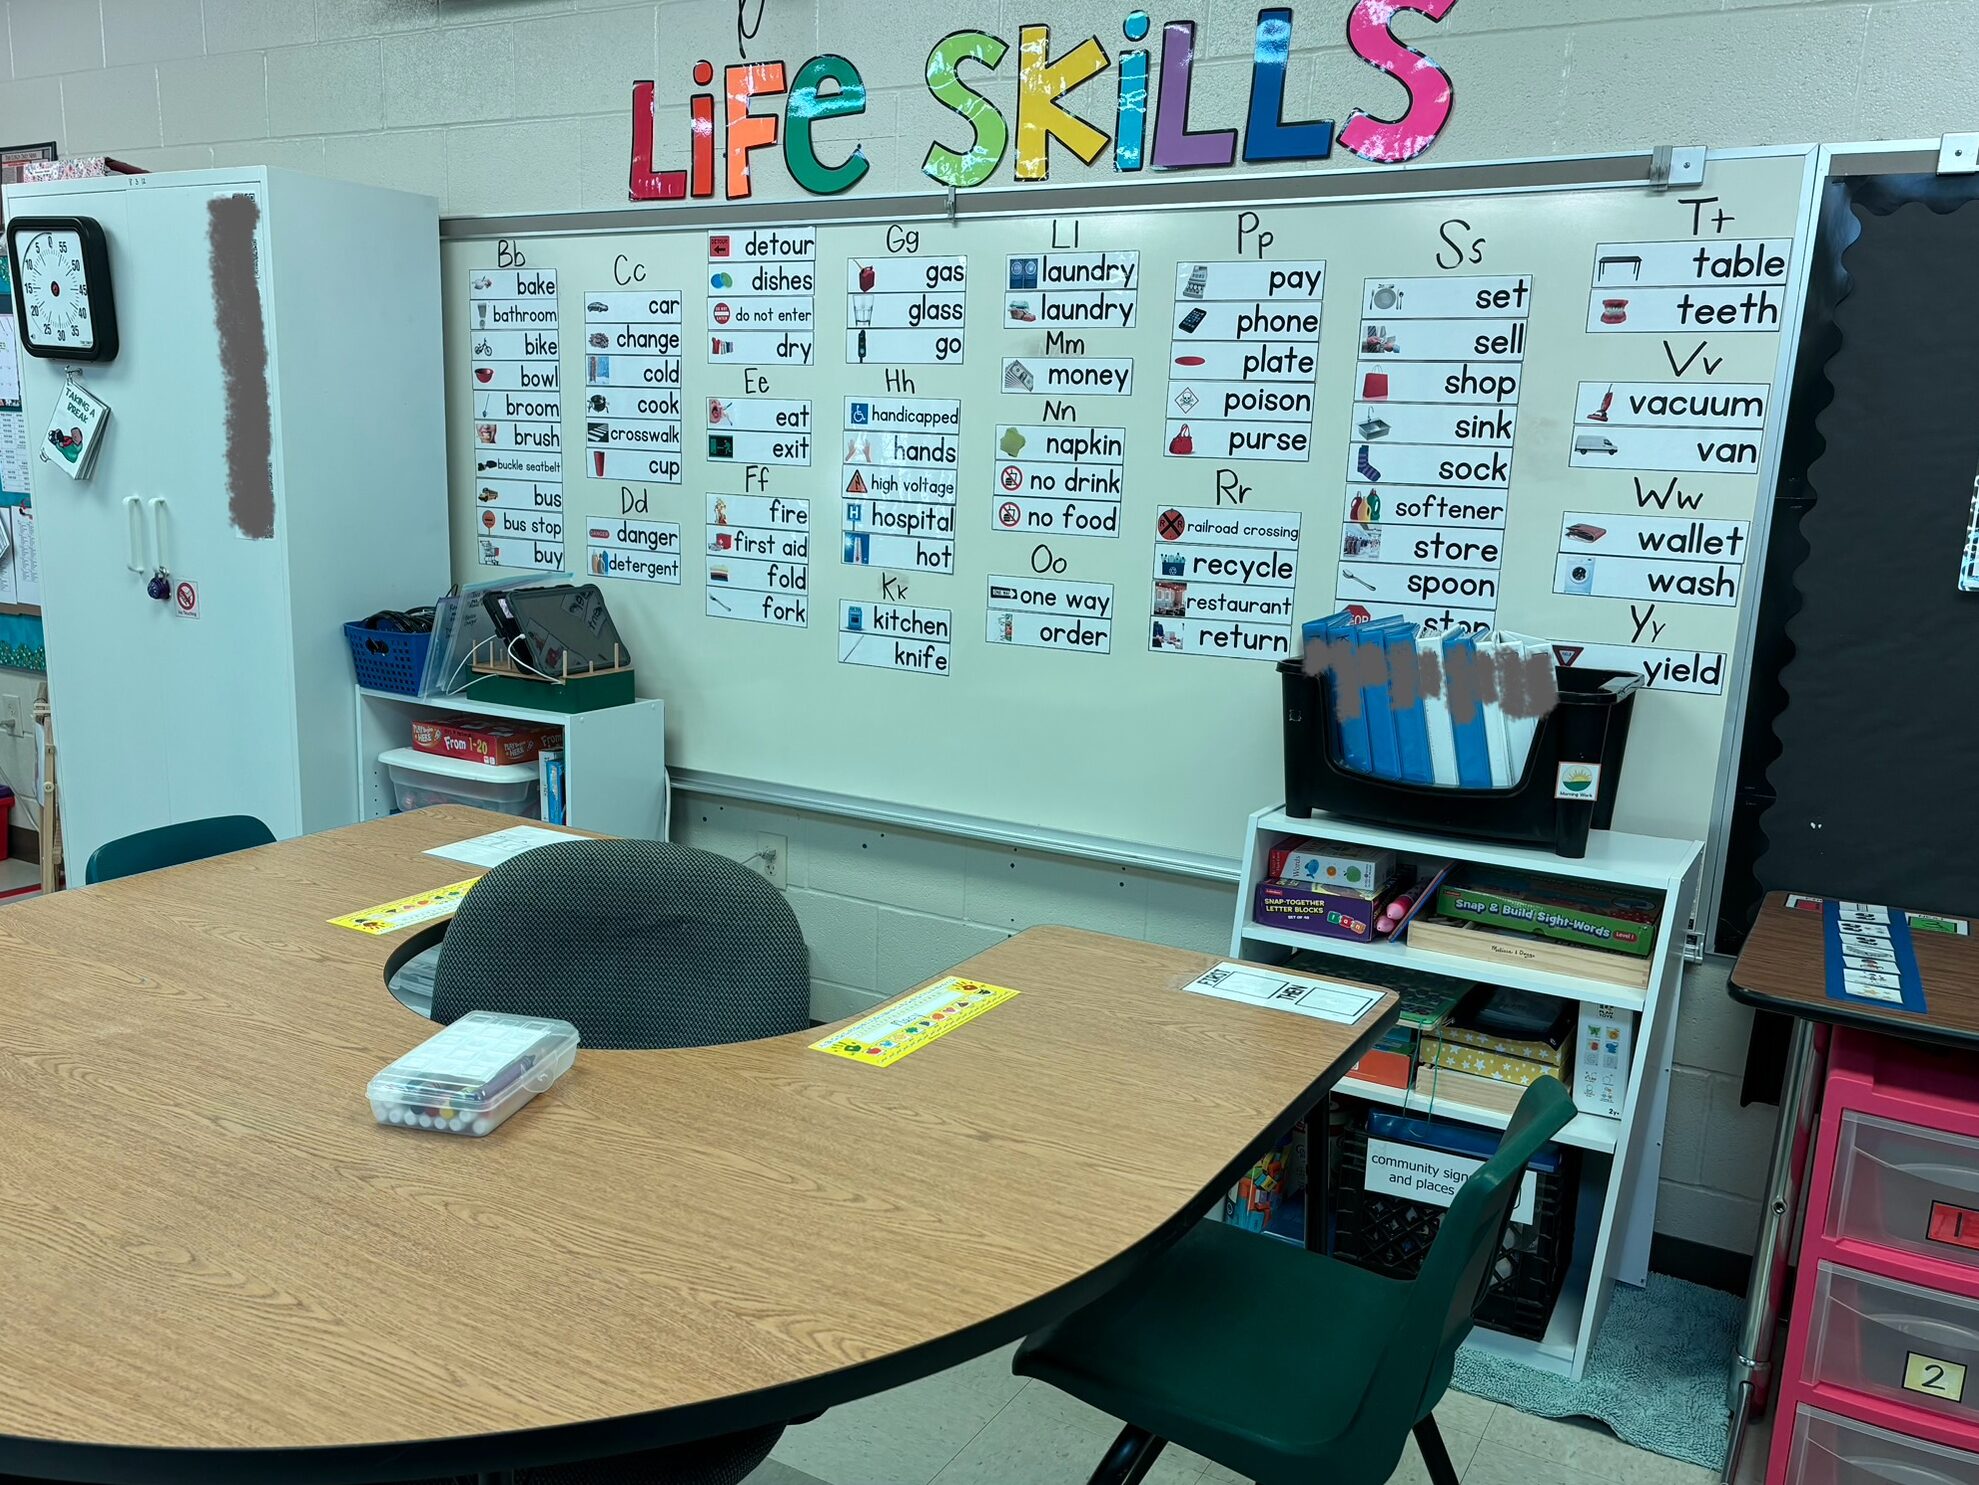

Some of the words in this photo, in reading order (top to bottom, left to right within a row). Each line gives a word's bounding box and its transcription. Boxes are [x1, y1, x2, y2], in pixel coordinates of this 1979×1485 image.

[59, 241, 68, 253] 55
[745, 231, 815, 256] detour
[886, 224, 919, 254] Gg
[1051, 219, 1078, 249] Ll
[1237, 212, 1274, 260] Pp
[1436, 219, 1486, 270] Ss
[35, 242, 40, 254] 5
[498, 239, 526, 268] Bb
[1692, 243, 1785, 278] table
[25, 259, 33, 271] 10
[71, 259, 81, 271] 50
[613, 254, 646, 285] Cc
[752, 265, 813, 292] dishes
[926, 265, 964, 289] gas
[1042, 253, 1135, 288] laundry
[24, 282, 33, 294] 15
[79, 284, 88, 296] 45
[517, 272, 555, 295] bake
[1269, 270, 1322, 296] pay
[1475, 279, 1529, 310] set
[30, 305, 39, 317] 20
[78, 307, 87, 319] 40
[493, 305, 557, 323] bathroom
[648, 299, 680, 315] car
[735, 306, 751, 322] do
[753, 307, 774, 322] not
[778, 308, 812, 322] enter
[908, 294, 963, 327] glass
[1041, 292, 1134, 327] laundry
[1677, 290, 1778, 325] teeth
[43, 323, 52, 335] 25
[70, 325, 80, 337] 35
[1237, 303, 1318, 339] phone
[57, 330, 66, 341] 30
[525, 332, 558, 355] bike
[616, 324, 680, 355] change
[776, 332, 812, 365] dry
[935, 337, 961, 361] go
[1045, 330, 1085, 355] Mm
[1473, 323, 1525, 355] sell
[643, 359, 680, 383] cold
[1242, 344, 1314, 380] plate
[1663, 340, 1723, 377] Vv
[521, 365, 559, 388] bowl
[744, 368, 770, 395] Ee
[885, 368, 916, 394] Hh
[1048, 366, 1129, 393] money
[1444, 363, 1516, 403] shop
[65, 387, 90, 412] TAKING
[89, 409, 96, 418] A
[67, 402, 88, 424] BREAK
[506, 394, 559, 416] broom
[637, 391, 680, 414] cook
[872, 404, 959, 428] handicapped
[1043, 400, 1076, 422] Nn
[1224, 388, 1311, 417] poison
[1629, 395, 1763, 417] vacuum
[776, 405, 810, 428] eat
[1455, 409, 1513, 439] sink
[514, 424, 560, 447] brush
[610, 426, 680, 444] crosswalk
[772, 436, 810, 459] exit
[1047, 428, 1122, 461] napkin
[1228, 430, 1307, 456] purse
[894, 435, 956, 464] hands
[1697, 443, 1757, 464] van
[498, 458, 524, 471] buckle
[526, 460, 561, 473] seatbelt
[649, 459, 680, 481] cup
[745, 465, 770, 493] Ff
[1438, 451, 1508, 482] sock
[871, 473, 898, 493] high
[902, 476, 954, 497] voltage
[1030, 472, 1055, 491] no
[1064, 467, 1120, 494] drink
[1216, 468, 1252, 506] Rr
[1634, 476, 1704, 510] Ww
[534, 484, 562, 507] bus
[621, 486, 648, 515] Dd
[1395, 494, 1503, 520] softener
[769, 499, 808, 524] fire
[850, 505, 859, 519] H
[872, 502, 954, 535] hospital
[1028, 509, 1054, 527] no
[1063, 504, 1117, 532] food
[503, 512, 527, 532] bus
[531, 517, 562, 539] stop
[617, 520, 678, 550] danger
[1187, 520, 1239, 536] railroad
[1243, 524, 1299, 542] crossing
[1638, 522, 1744, 556] wallet
[534, 542, 563, 570] buy
[734, 530, 776, 555] first
[784, 536, 808, 558] aid
[916, 541, 952, 569] hot
[1414, 532, 1498, 562] store
[609, 553, 678, 579] detergent
[1031, 544, 1067, 574] Oo
[1192, 551, 1293, 584] recycle
[767, 563, 807, 590] fold
[882, 571, 909, 602] Kk
[1407, 574, 1495, 600] spoon
[1648, 566, 1735, 598] wash
[762, 595, 806, 623] fork
[1020, 588, 1056, 606] one
[1066, 592, 1110, 616] way
[1186, 592, 1292, 615] restaurant
[874, 606, 948, 637] kitchen
[1039, 619, 1108, 647] order
[1630, 604, 1666, 643] Yy
[1199, 624, 1288, 652] return
[894, 641, 947, 670] knife
[1643, 653, 1722, 687] yield
[443, 736, 466, 751] From
[468, 737, 488, 754] 1-20
[1264, 898, 1325, 907] SNAP-TOGETHER
[1294, 906, 1324, 914] BLOCKS
[1455, 898, 1486, 913] Snap
[1489, 903, 1499, 913] &
[1502, 905, 1534, 919] Build
[1537, 911, 1611, 939] Sight-Words
[1615, 931, 1630, 940] Level
[1197, 968, 1231, 987] FIRST
[1276, 984, 1308, 1001] THEN
[1371, 1154, 1440, 1178] community
[1389, 1172, 1412, 1187] and
[1416, 1178, 1455, 1195] places
[1921, 1364, 1946, 1391] 2
